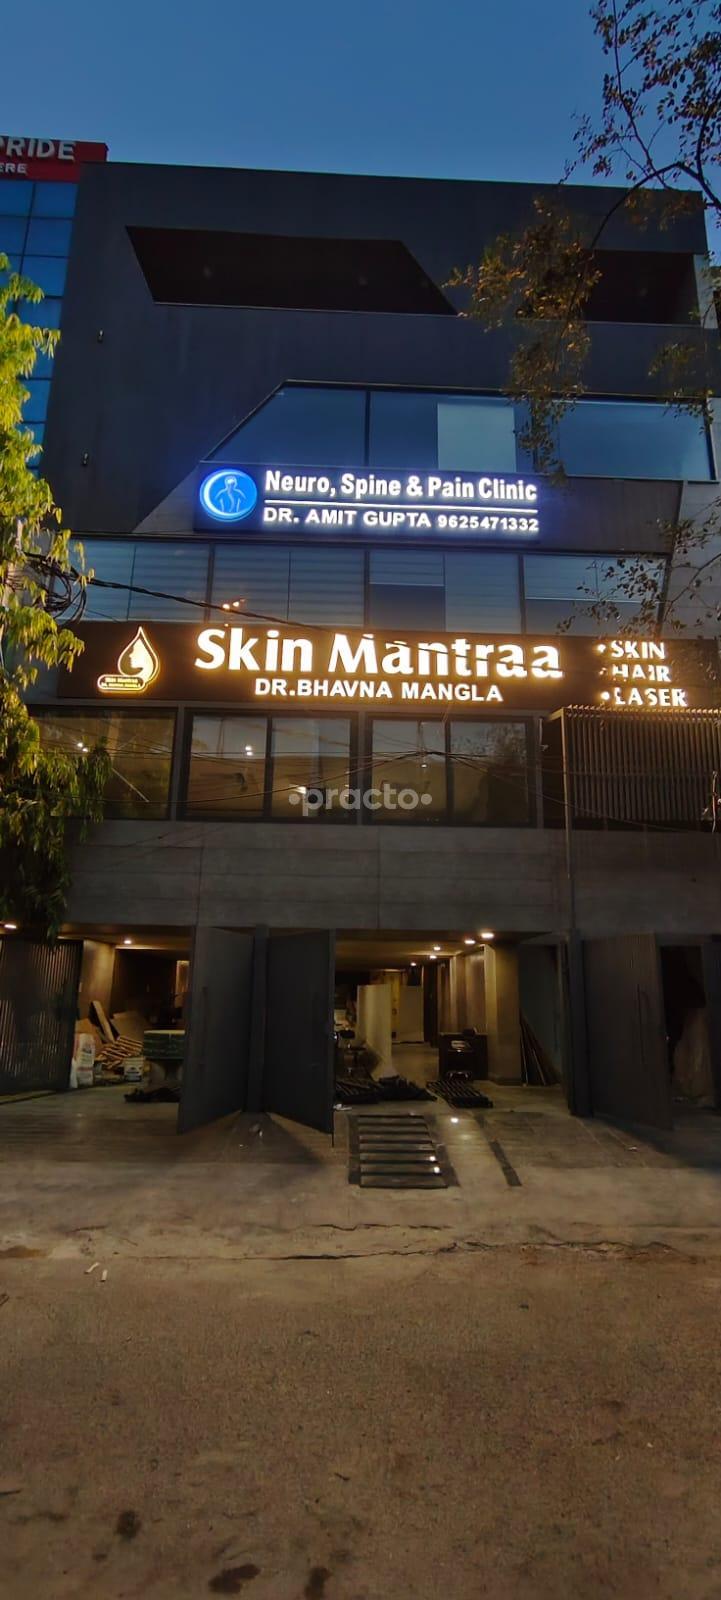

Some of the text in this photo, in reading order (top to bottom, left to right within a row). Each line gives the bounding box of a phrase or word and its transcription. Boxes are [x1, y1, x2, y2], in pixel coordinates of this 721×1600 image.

[265, 470, 537, 500] Neuro, Spine & Pain Clinic
[263, 507, 539, 532] DR. AMIT GUPTA 9625471332
[194, 627, 563, 679] Skin Mantraa
[610, 640, 666, 659] SKIN
[401, 681, 504, 702] MANGLA
[614, 687, 688, 707] LASER
